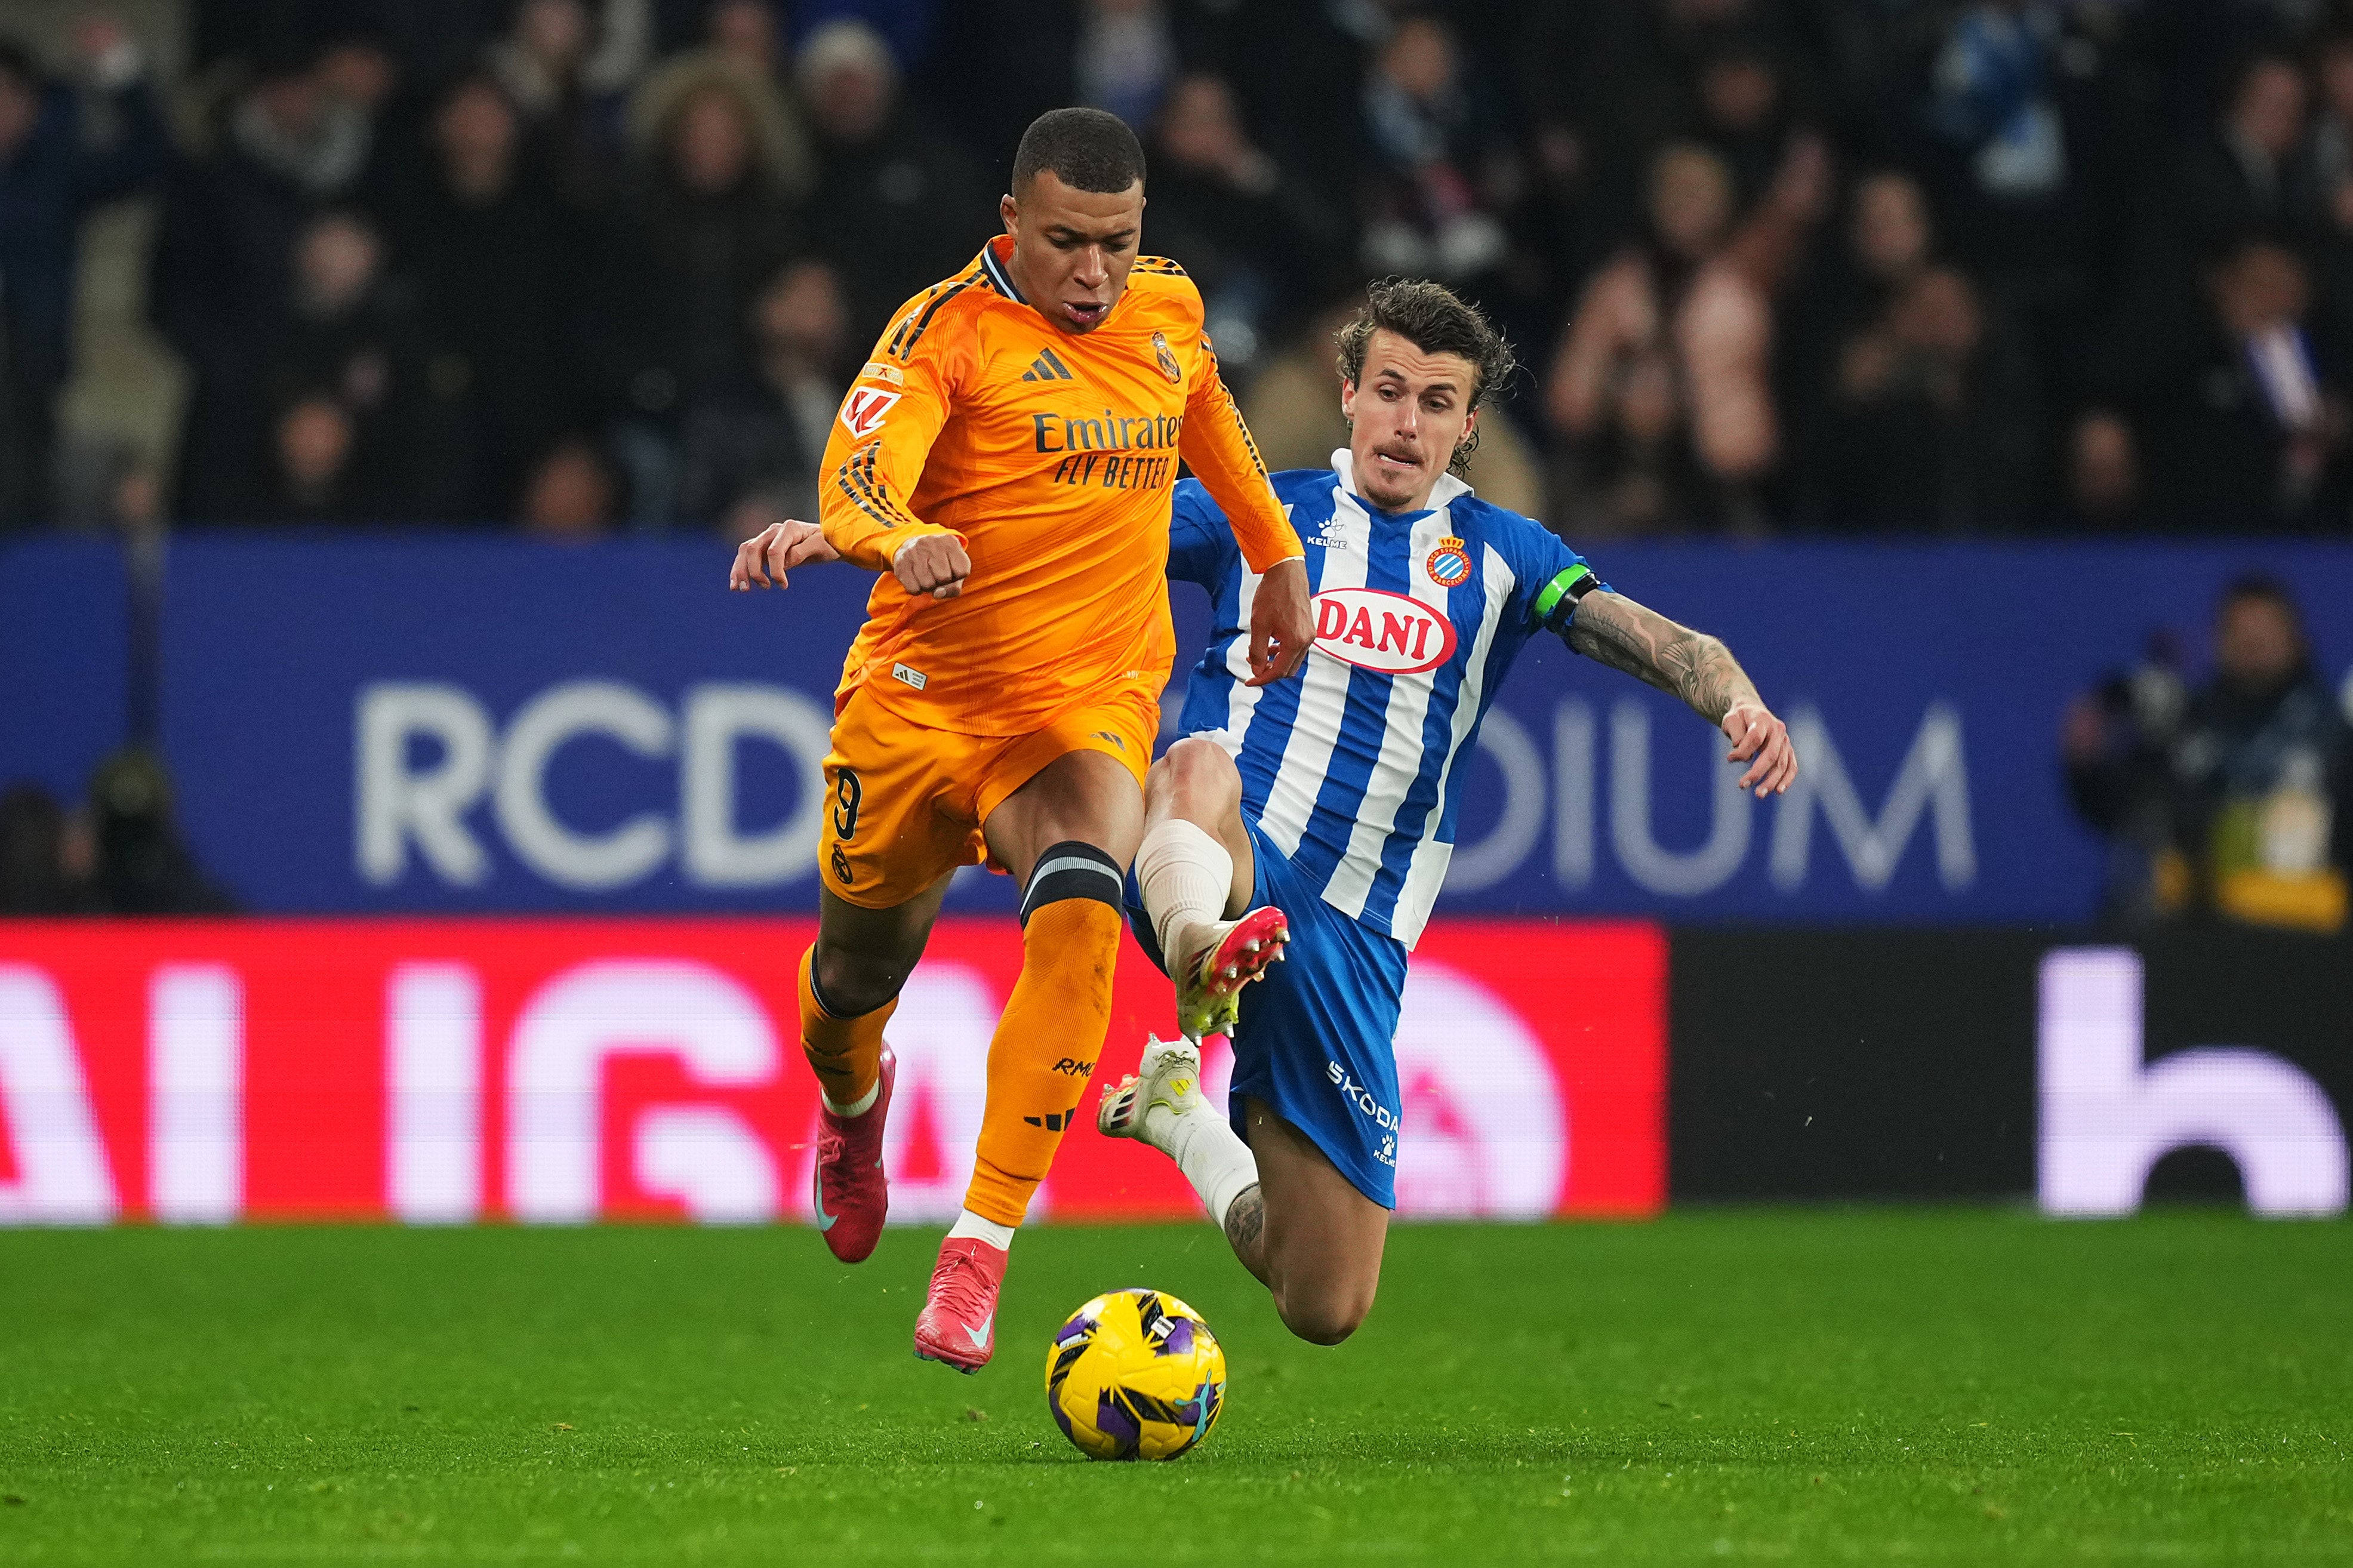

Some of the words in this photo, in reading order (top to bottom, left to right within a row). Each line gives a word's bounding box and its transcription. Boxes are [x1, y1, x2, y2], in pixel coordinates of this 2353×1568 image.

[1054, 455, 1098, 485] FLY
[1103, 456, 1169, 489] BETTER
[1307, 536, 1347, 549] KELME
[1440, 548, 1470, 565] ESPANYOL
[1433, 569, 1469, 585] BARCELONA
[1316, 599, 1432, 660] DANI
[358, 682, 836, 889] RCD
[833, 767, 862, 840] 9
